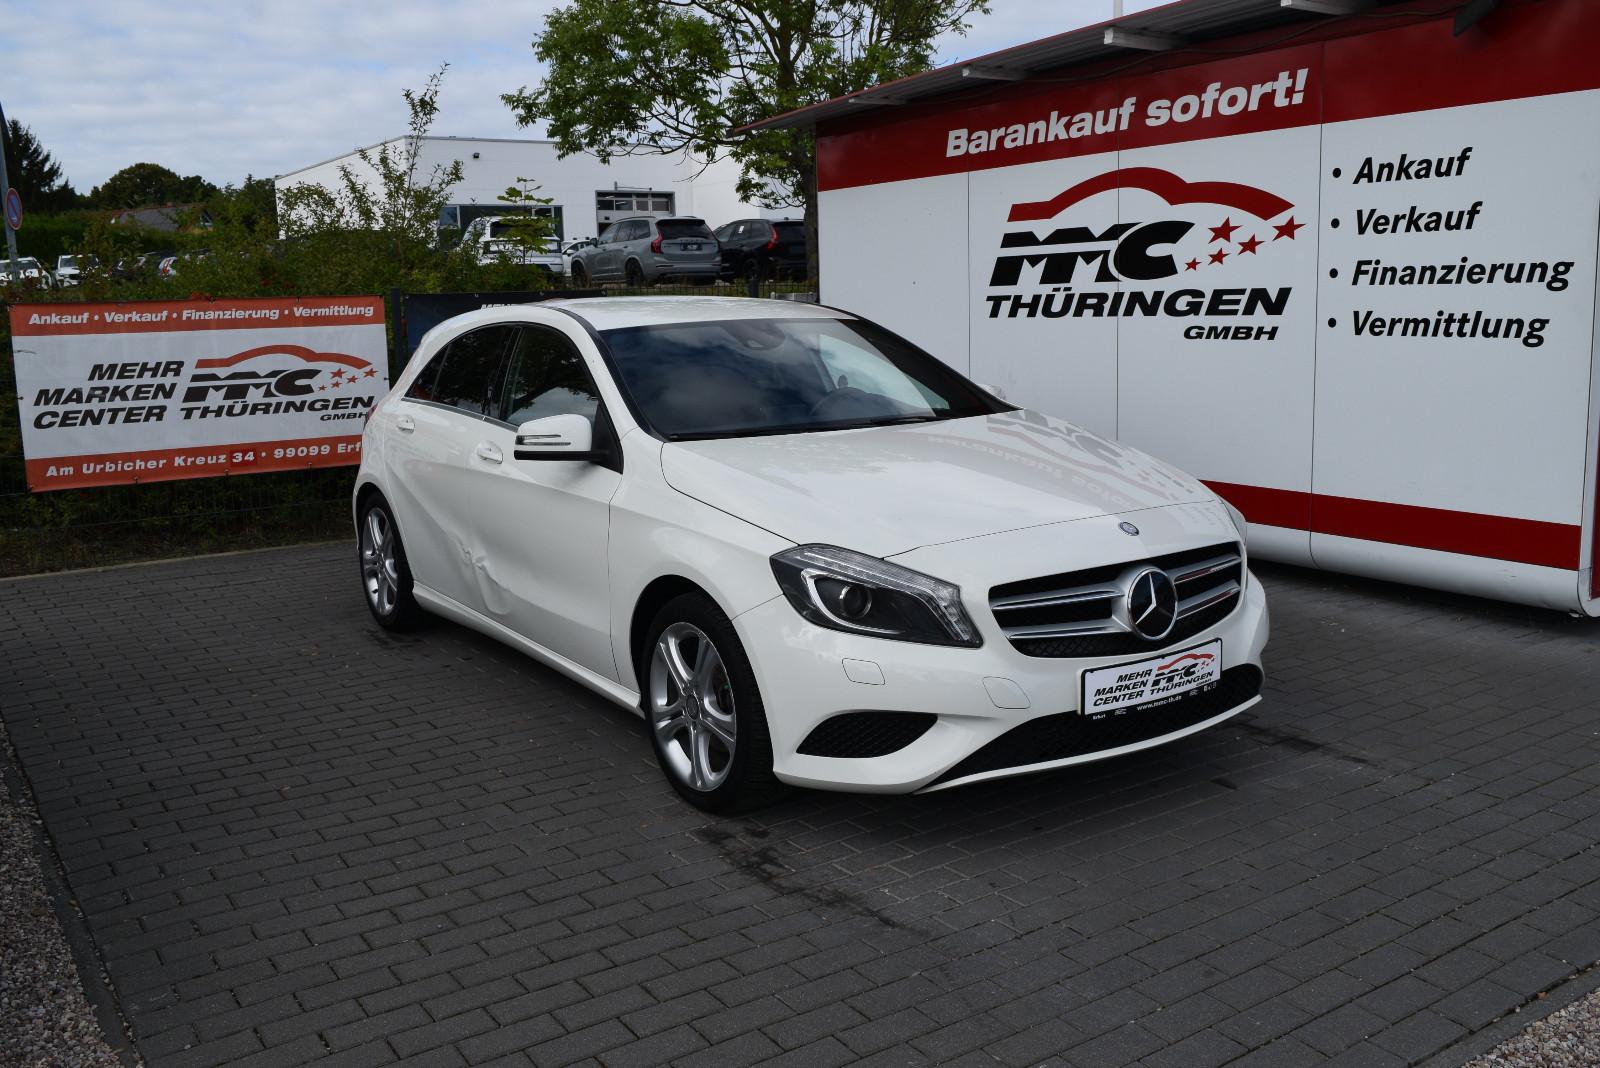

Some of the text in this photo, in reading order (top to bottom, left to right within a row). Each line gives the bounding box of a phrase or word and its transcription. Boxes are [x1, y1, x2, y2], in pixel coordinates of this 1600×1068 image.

[946, 68, 1308, 157] Barankauf sofort!
[1353, 147, 1472, 184] Ankauf
[1356, 201, 1483, 235] Verkauf
[1352, 257, 1574, 291] Finanzierung
[29, 305, 374, 325] Ankauf Verkauf Finanzierung Vermittlung
[985, 287, 1292, 318] THÜRINGEN
[1183, 326, 1278, 340] GMBH
[1353, 310, 1549, 347] Vermittlung
[88, 361, 184, 381] MEHR
[33, 383, 177, 406] MARKEN
[33, 396, 375, 429] CENTER THÜRINGEN
[320, 411, 368, 421] GMBH
[46, 464, 73, 477] Am
[82, 458, 166, 473] Urbicher
[174, 454, 226, 468] Kreuz
[232, 451, 255, 462] 34
[274, 445, 331, 458] 99099
[1093, 690, 1144, 706] CENTER
[1150, 671, 1213, 695] THÜRINGEN
[1094, 679, 1148, 697] MARKEN
[1117, 669, 1152, 683] MEHR
